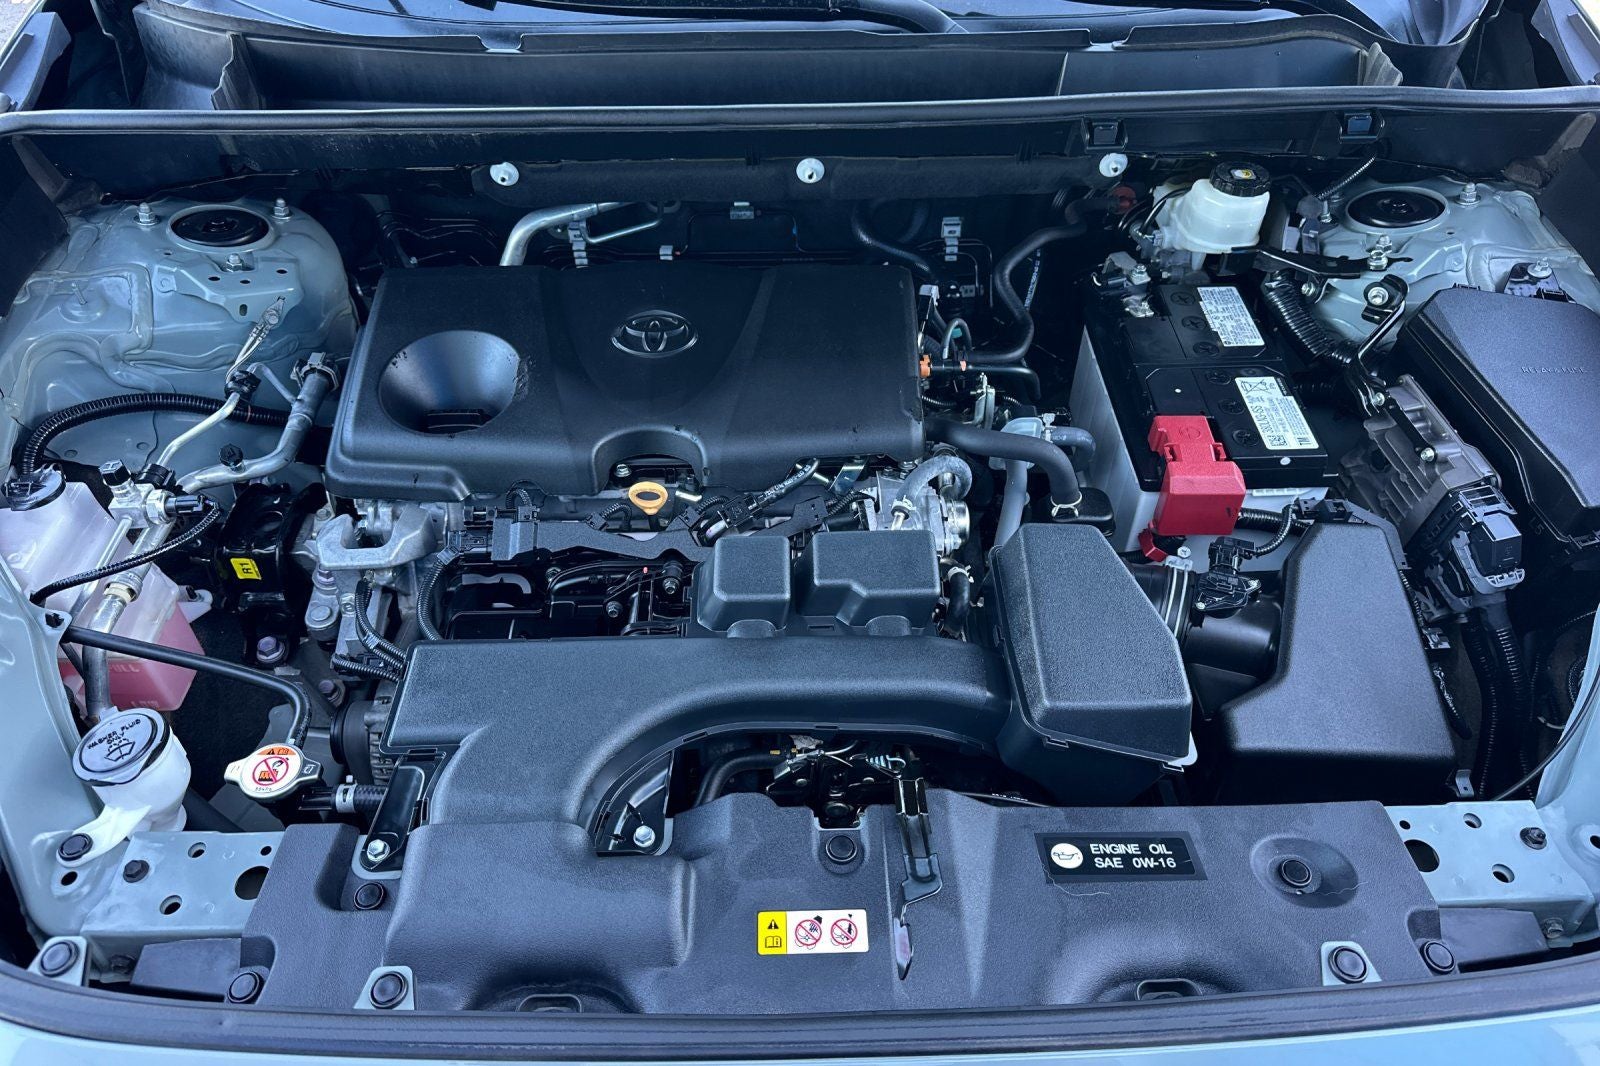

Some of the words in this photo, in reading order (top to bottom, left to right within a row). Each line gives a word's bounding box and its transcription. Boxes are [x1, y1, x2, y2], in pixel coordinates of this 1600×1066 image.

[1089, 843, 1142, 855] ENGINE
[1149, 843, 1173, 855] OIL
[1094, 857, 1124, 869] SAE
[1132, 857, 1177, 869] 0W-16
